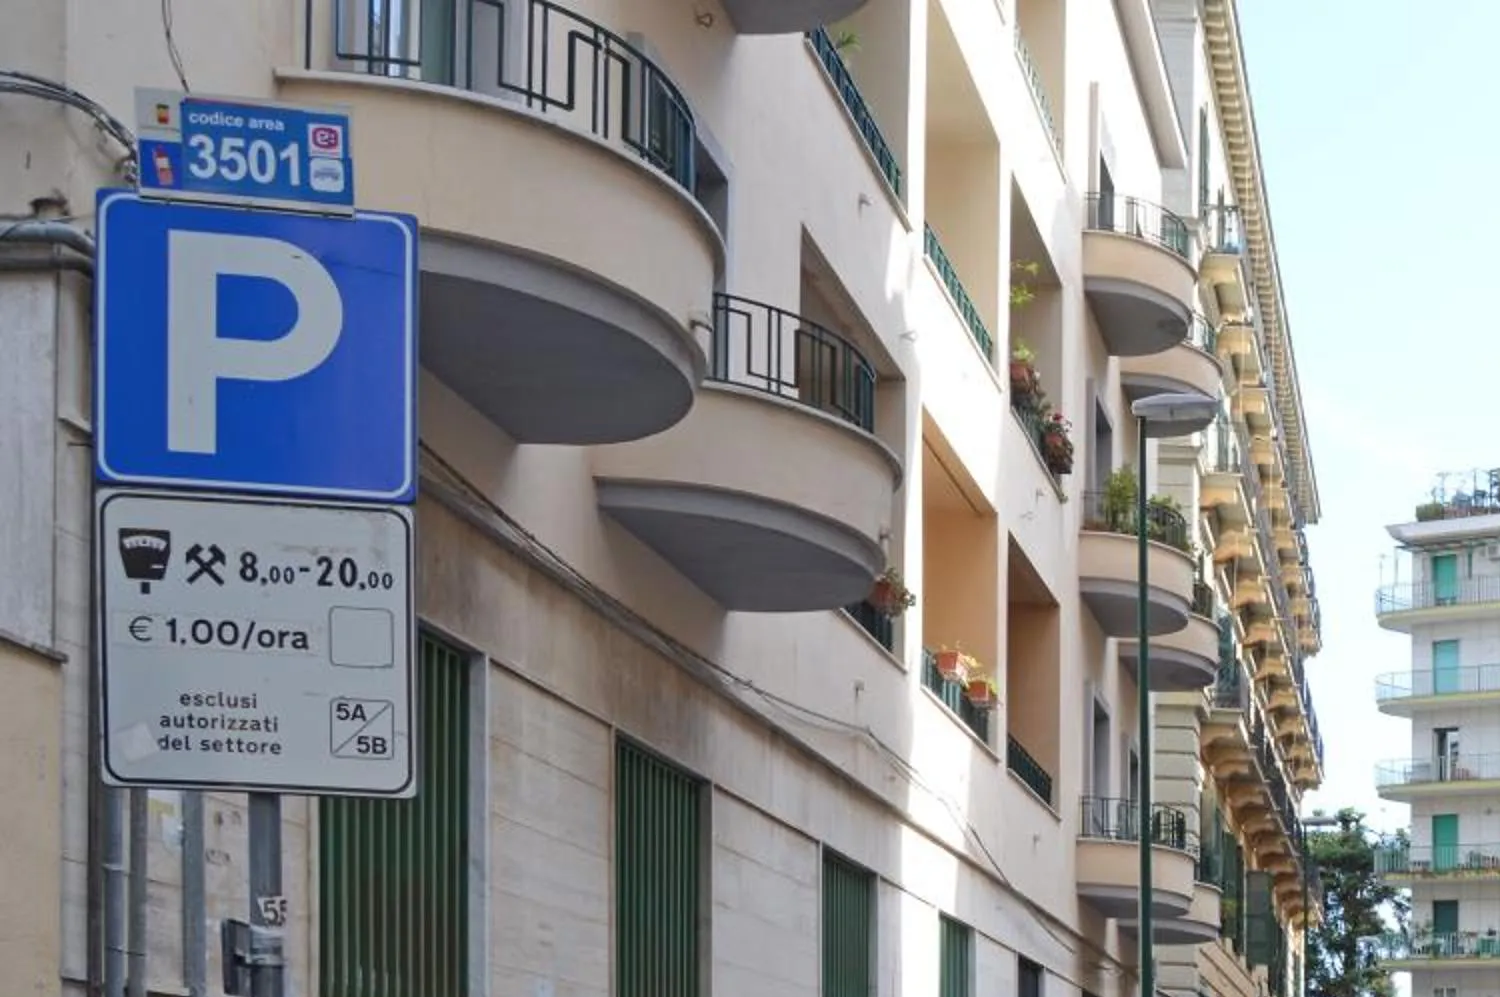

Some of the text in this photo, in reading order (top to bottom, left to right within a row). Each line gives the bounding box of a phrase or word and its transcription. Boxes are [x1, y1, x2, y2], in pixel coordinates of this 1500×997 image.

[188, 111, 285, 132] codice area
[189, 134, 301, 187] 3501
[167, 229, 343, 454] P
[128, 615, 154, 643] €
[179, 692, 258, 709] esclusi
[335, 702, 368, 722] 5A
[159, 713, 279, 733] autorizzati
[157, 734, 282, 755] del settore
[356, 736, 388, 755] 5B
